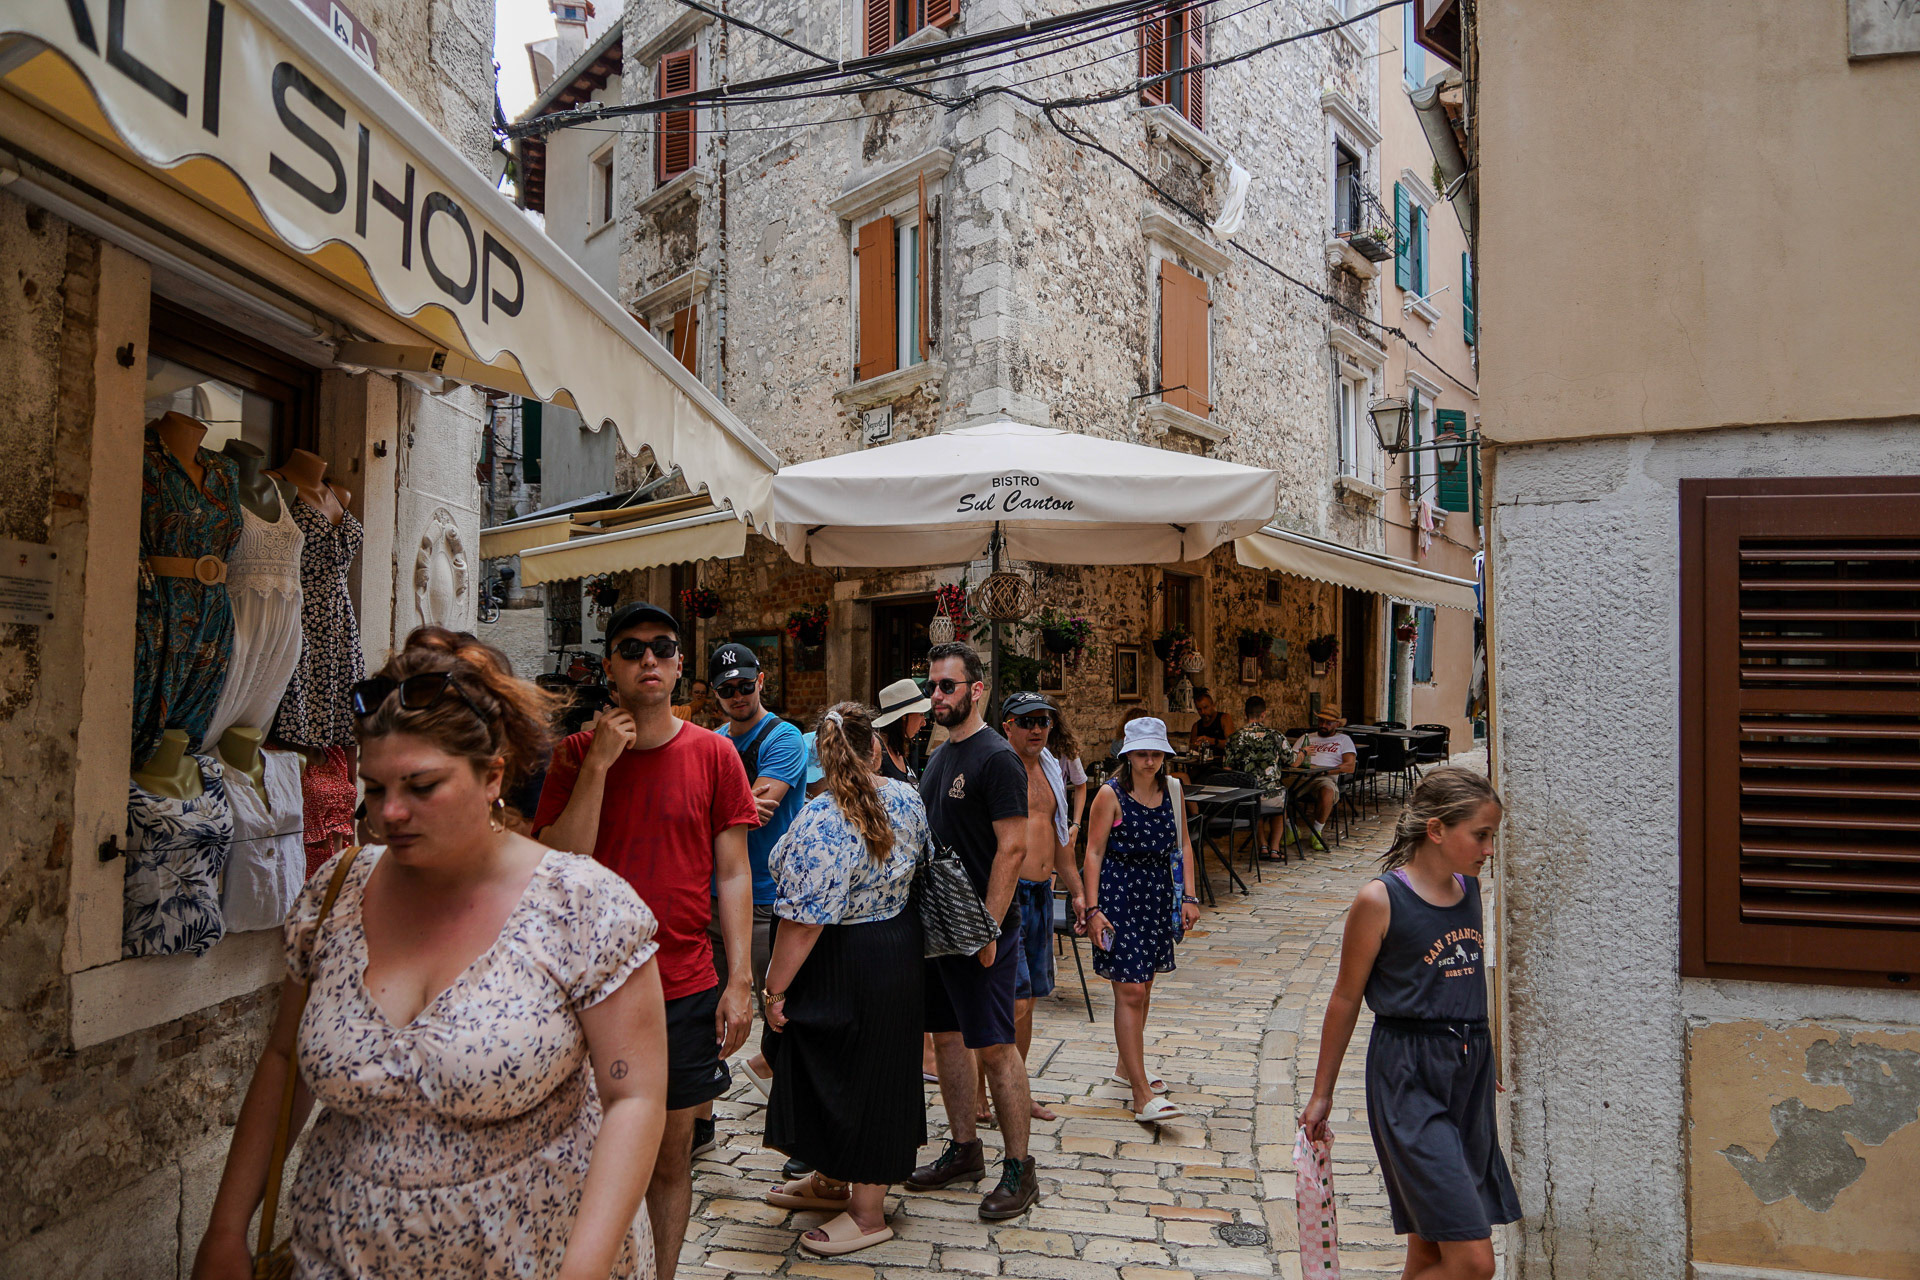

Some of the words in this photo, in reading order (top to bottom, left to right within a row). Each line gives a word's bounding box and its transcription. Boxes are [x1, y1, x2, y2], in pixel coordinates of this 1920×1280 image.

[268, 61, 525, 325] SHOP
[992, 475, 1040, 488] BISTRO
[956, 492, 996, 513] Sul
[1003, 489, 1075, 513] Canton
[721, 650, 737, 665] NY
[1424, 939, 1444, 965] SAN
